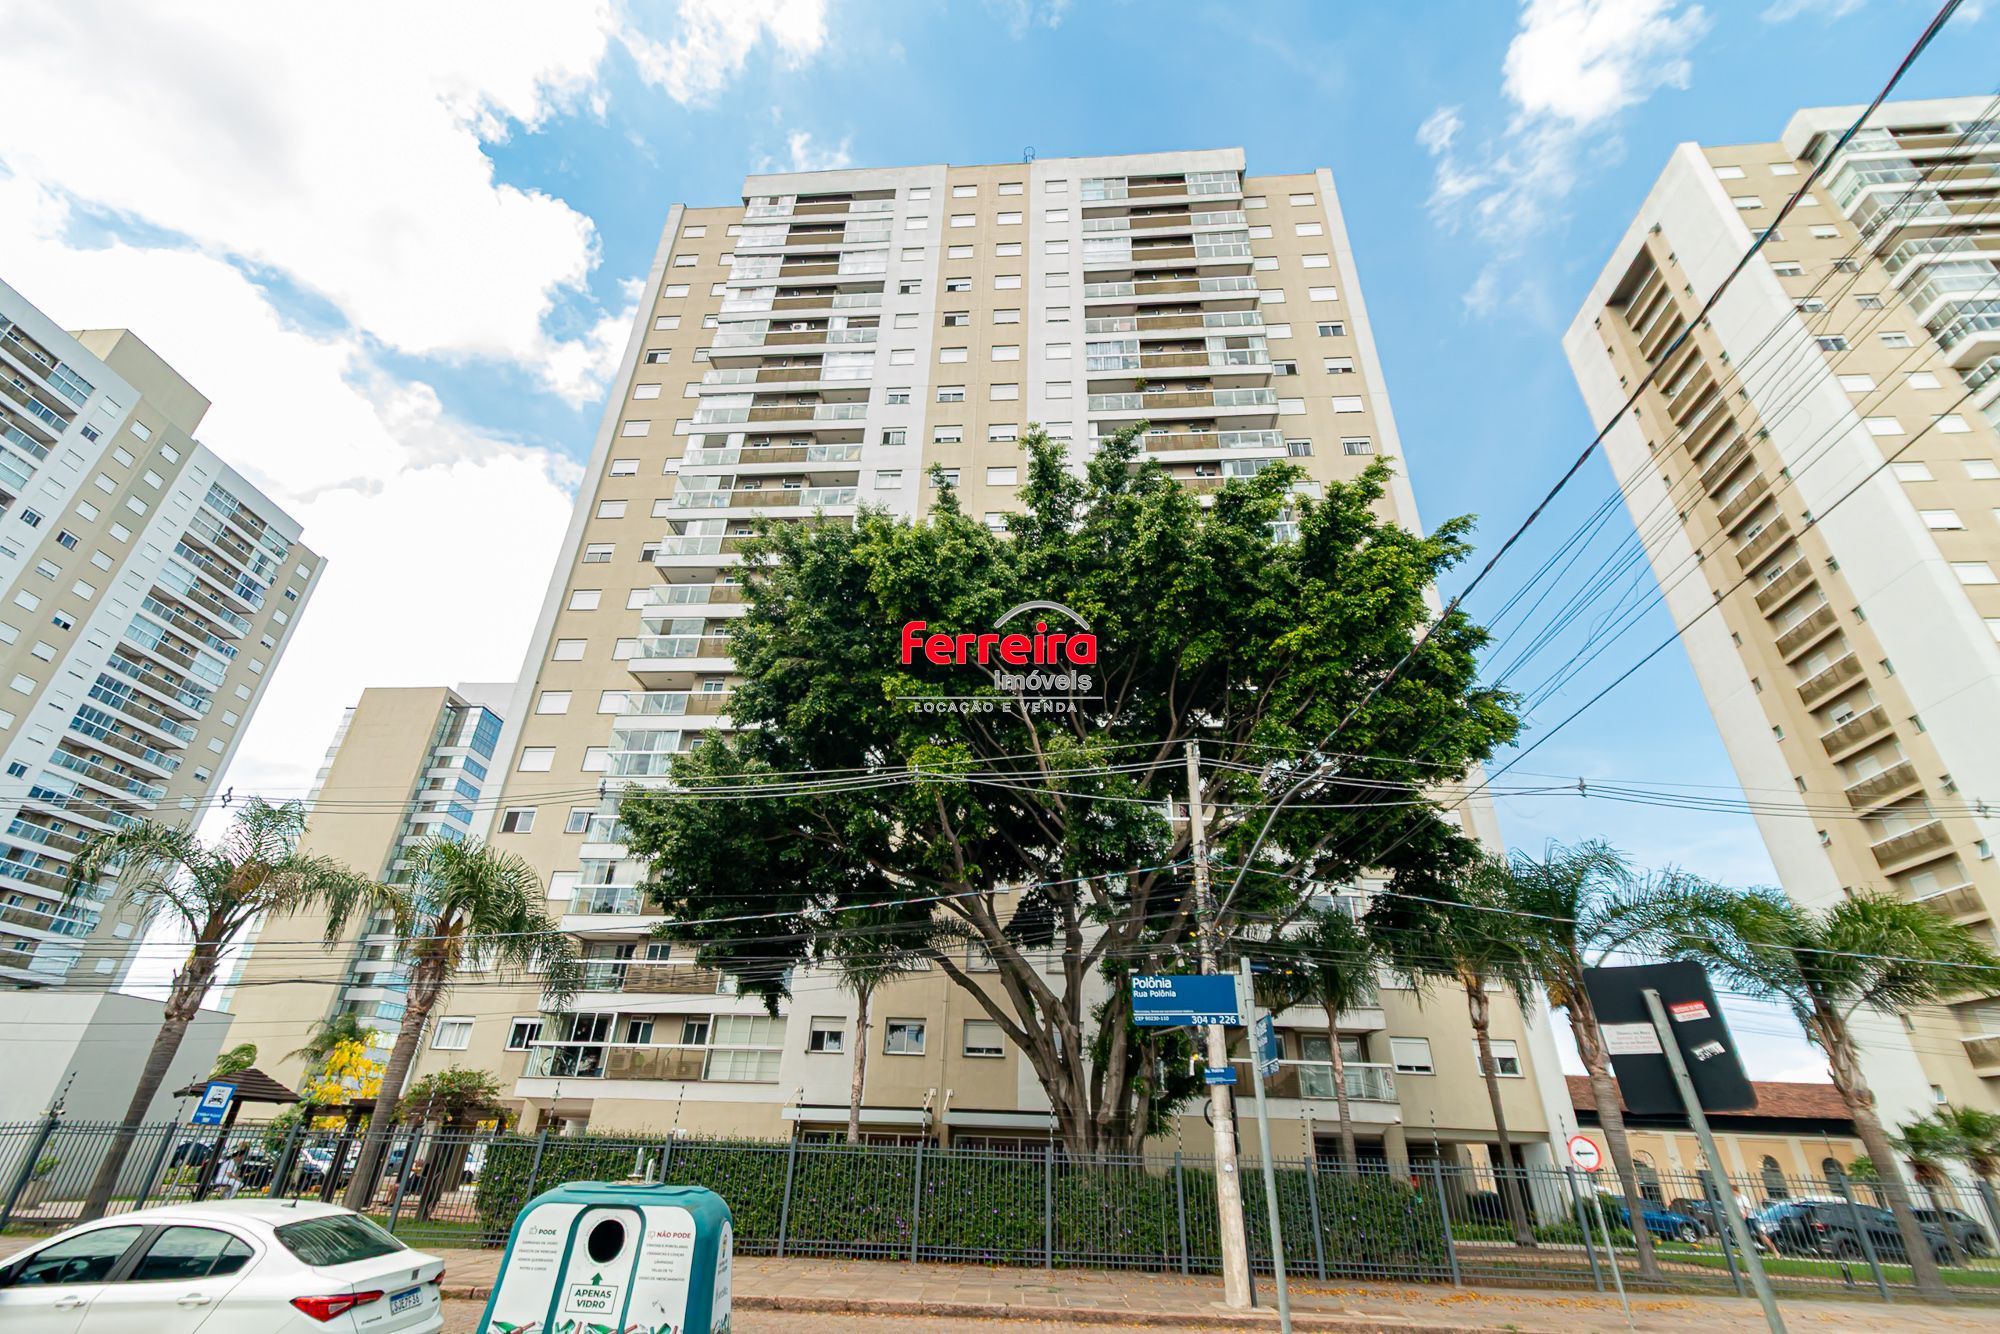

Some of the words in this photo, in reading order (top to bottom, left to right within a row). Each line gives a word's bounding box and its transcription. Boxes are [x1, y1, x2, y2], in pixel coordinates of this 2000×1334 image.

[1132, 976, 1172, 989] Polônia
[1133, 990, 1148, 998] Rua
[1149, 989, 1177, 998] Polônia
[1191, 1015, 1208, 1025] 304
[1219, 1015, 1237, 1024] 226
[656, 1230, 671, 1238] NÃO
[574, 1289, 612, 1299] APENAS
[576, 1299, 606, 1309] VIDRO
